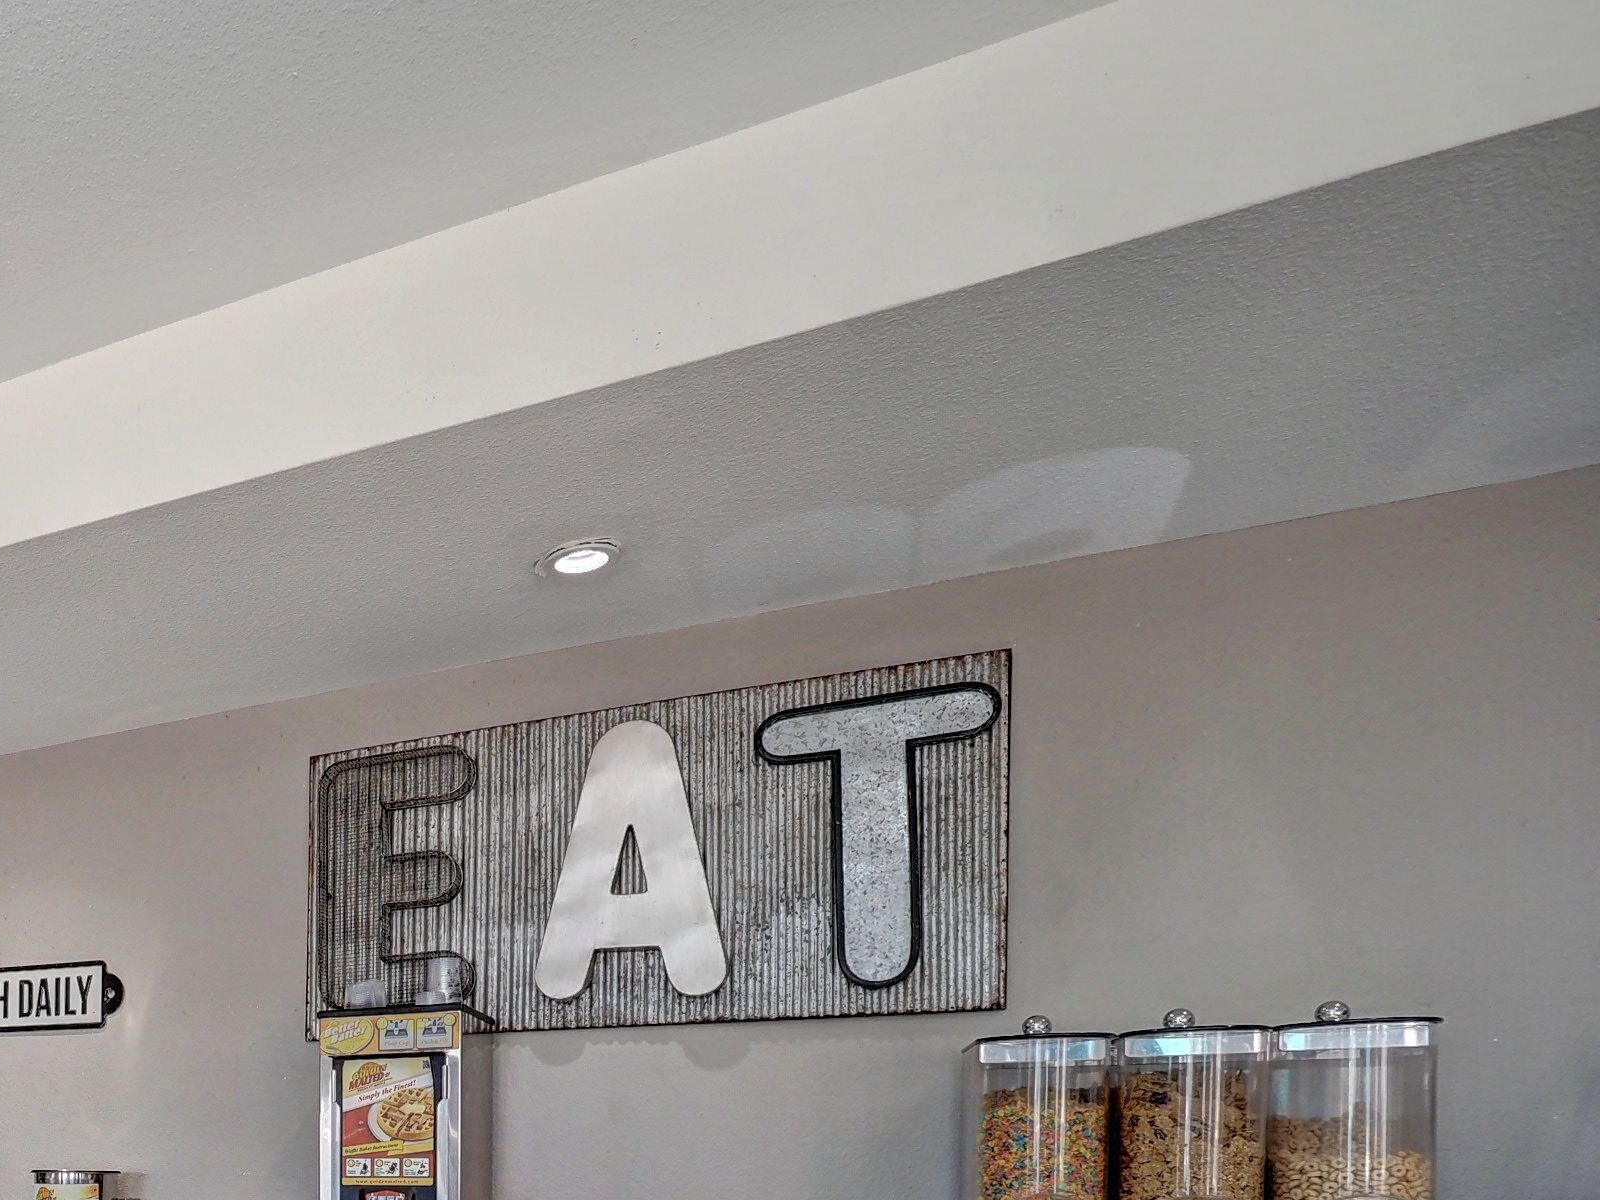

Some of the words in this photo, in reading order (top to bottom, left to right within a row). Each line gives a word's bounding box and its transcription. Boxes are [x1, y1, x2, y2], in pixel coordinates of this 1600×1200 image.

[317, 681, 1001, 1006] EAT
[18, 974, 94, 1018] DAILY
[348, 1072, 385, 1090] MALTED
[358, 1089, 380, 1103] Simply
[382, 1087, 392, 1095] the
[394, 1079, 417, 1092] Finest!
